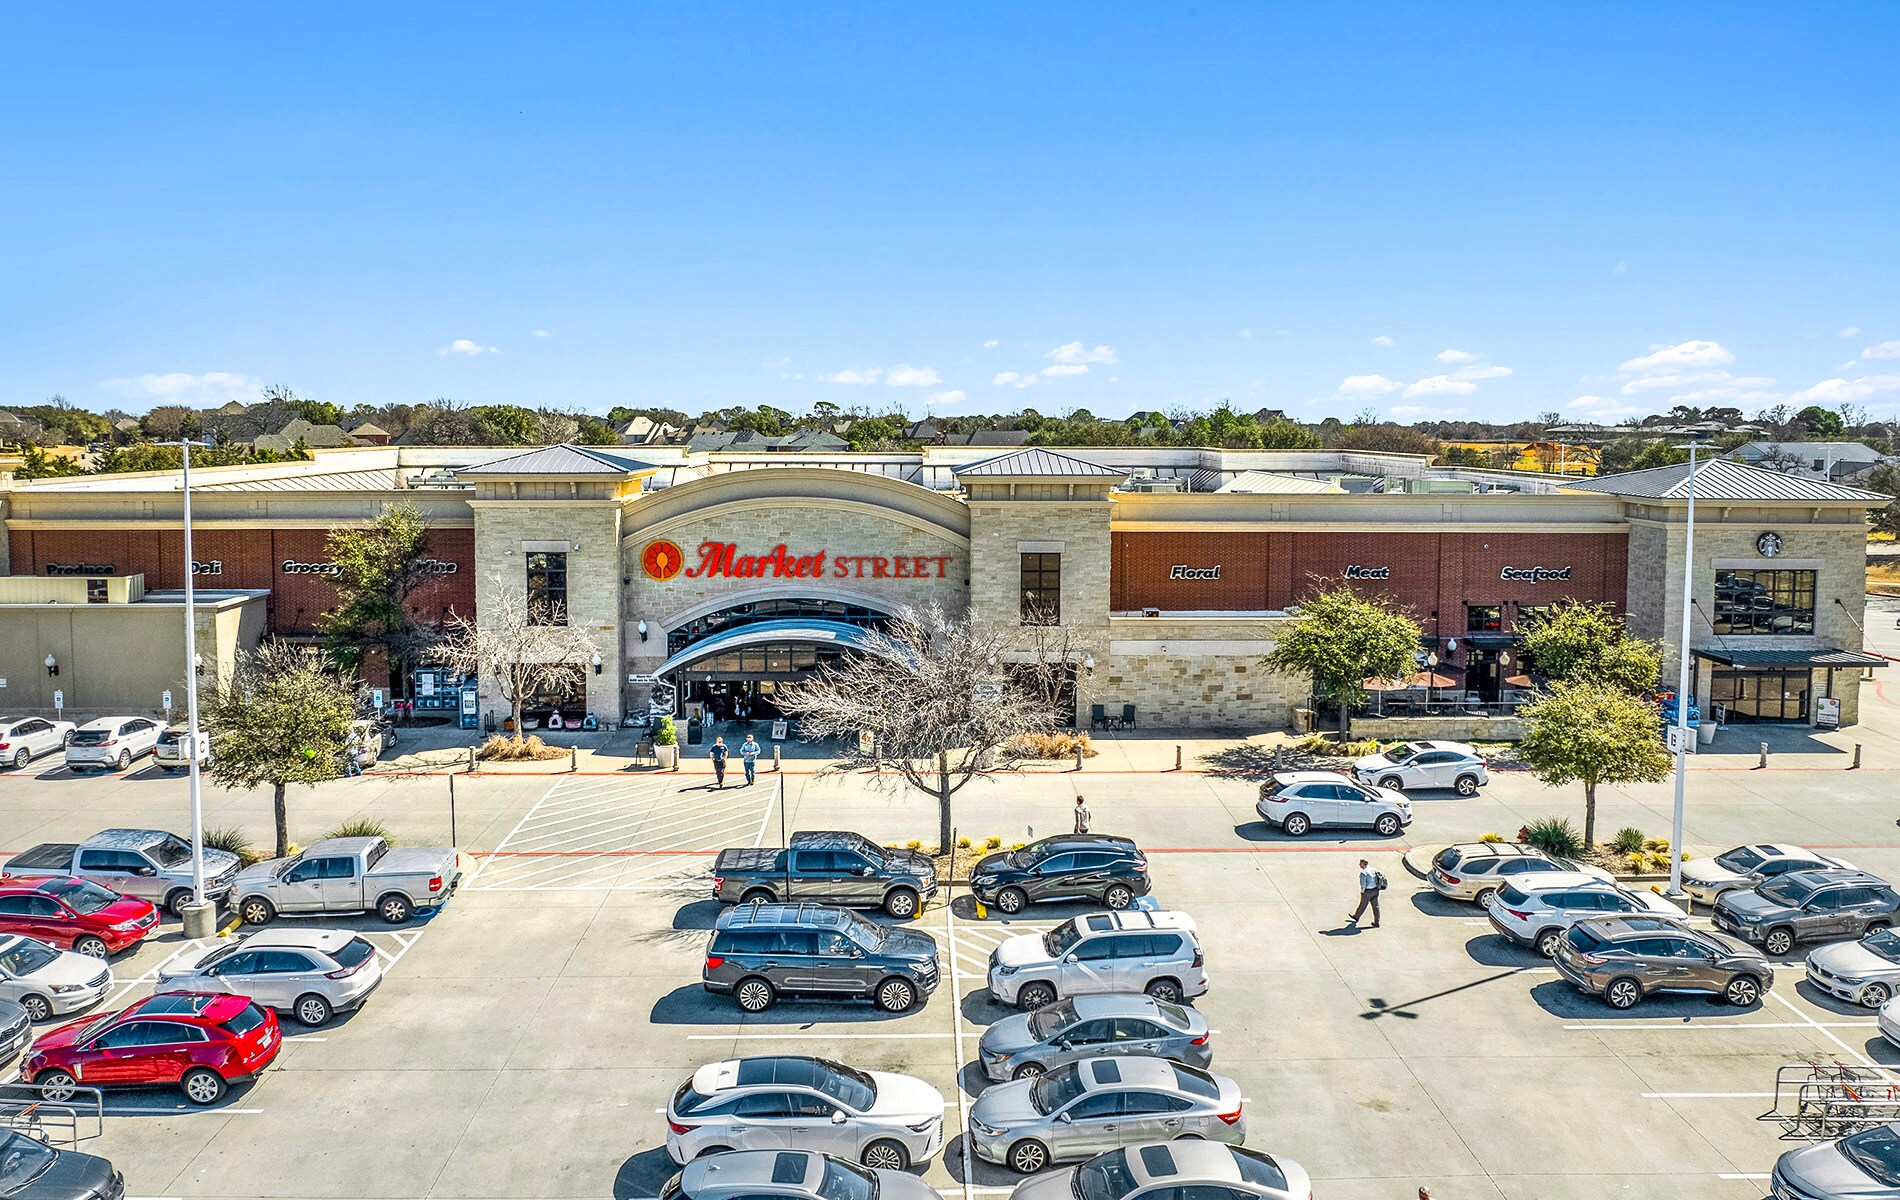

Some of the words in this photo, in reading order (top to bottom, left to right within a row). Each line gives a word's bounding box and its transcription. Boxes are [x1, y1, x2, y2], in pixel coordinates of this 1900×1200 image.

[191, 560, 222, 575] Deli
[685, 541, 827, 579] Market
[833, 556, 953, 579] STREET
[46, 562, 115, 576] Produce
[282, 560, 346, 577] Grocery
[1170, 564, 1221, 580] Floral
[1345, 565, 1390, 580] Meat
[1500, 565, 1571, 584] Seafood
[199, 740, 206, 754] C
